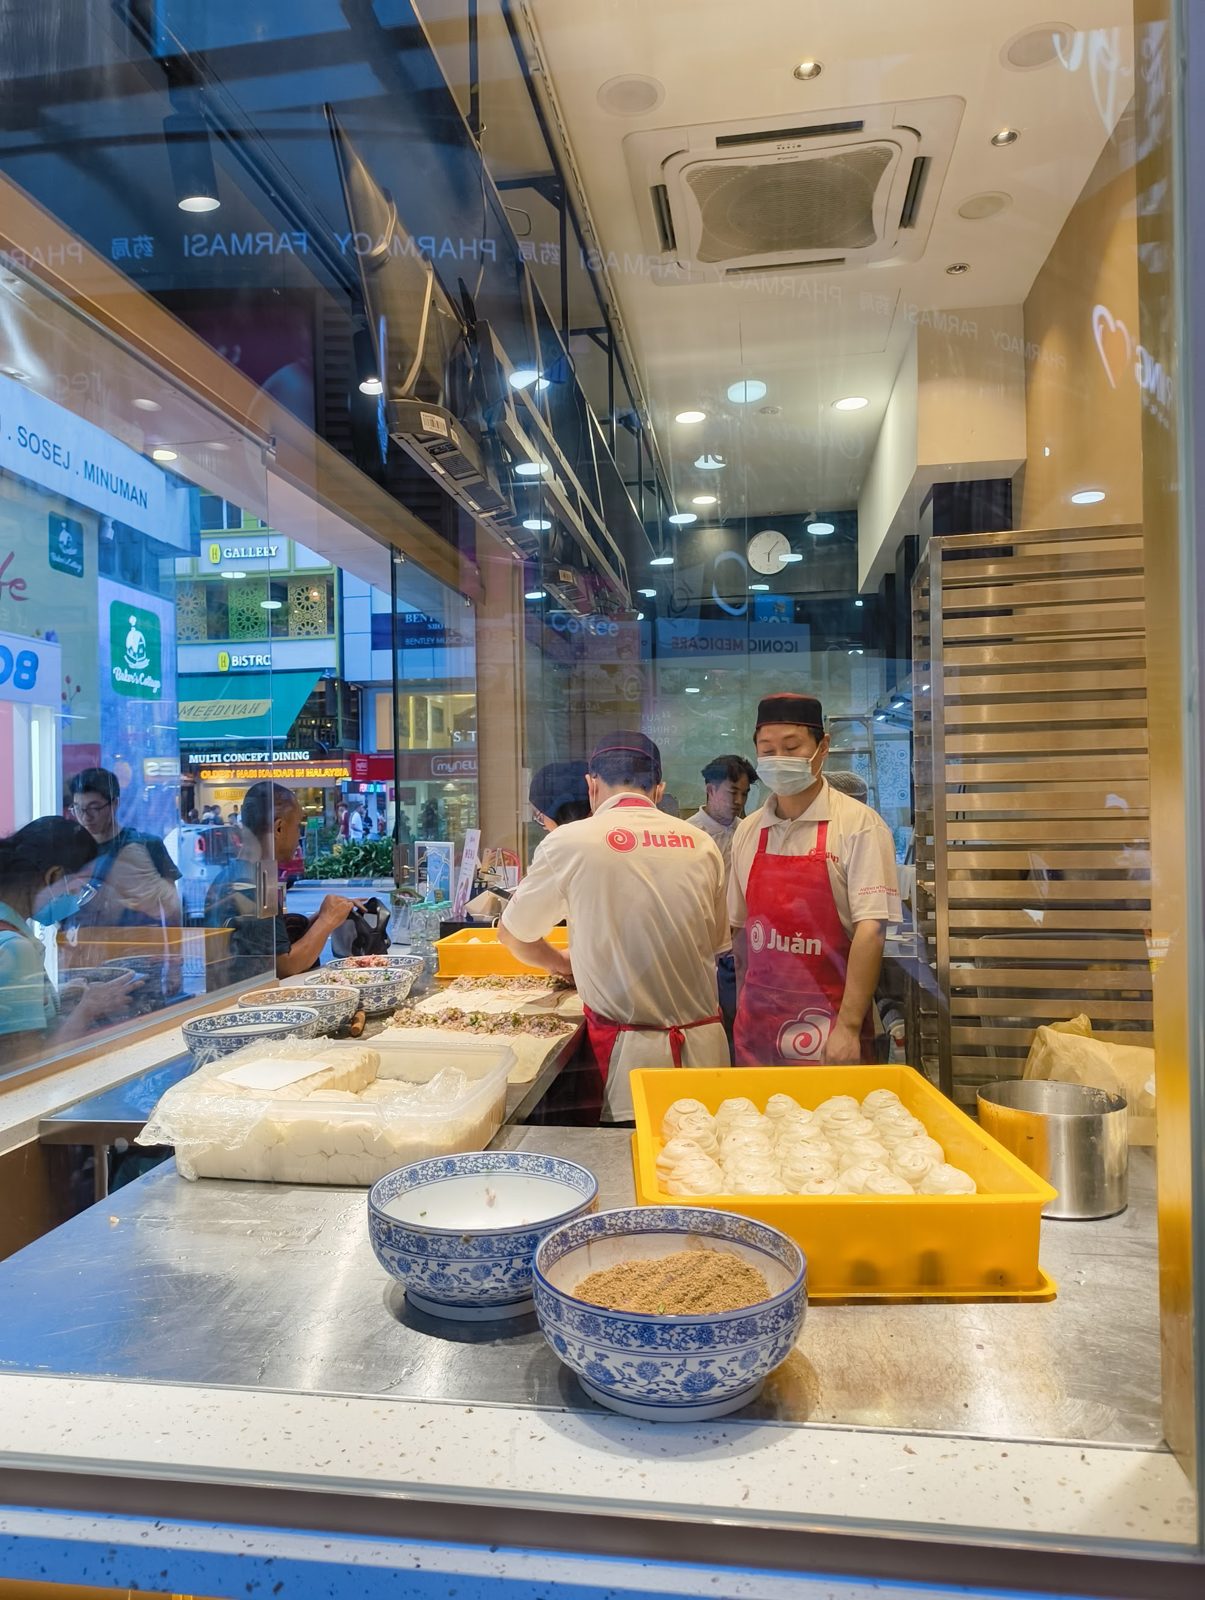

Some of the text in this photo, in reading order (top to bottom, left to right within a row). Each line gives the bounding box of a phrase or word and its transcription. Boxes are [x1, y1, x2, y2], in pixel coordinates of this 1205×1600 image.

[17, 425, 149, 510] SOSEJ MINUMAN
[189, 751, 309, 764] MULTI CONCEPT DINING
